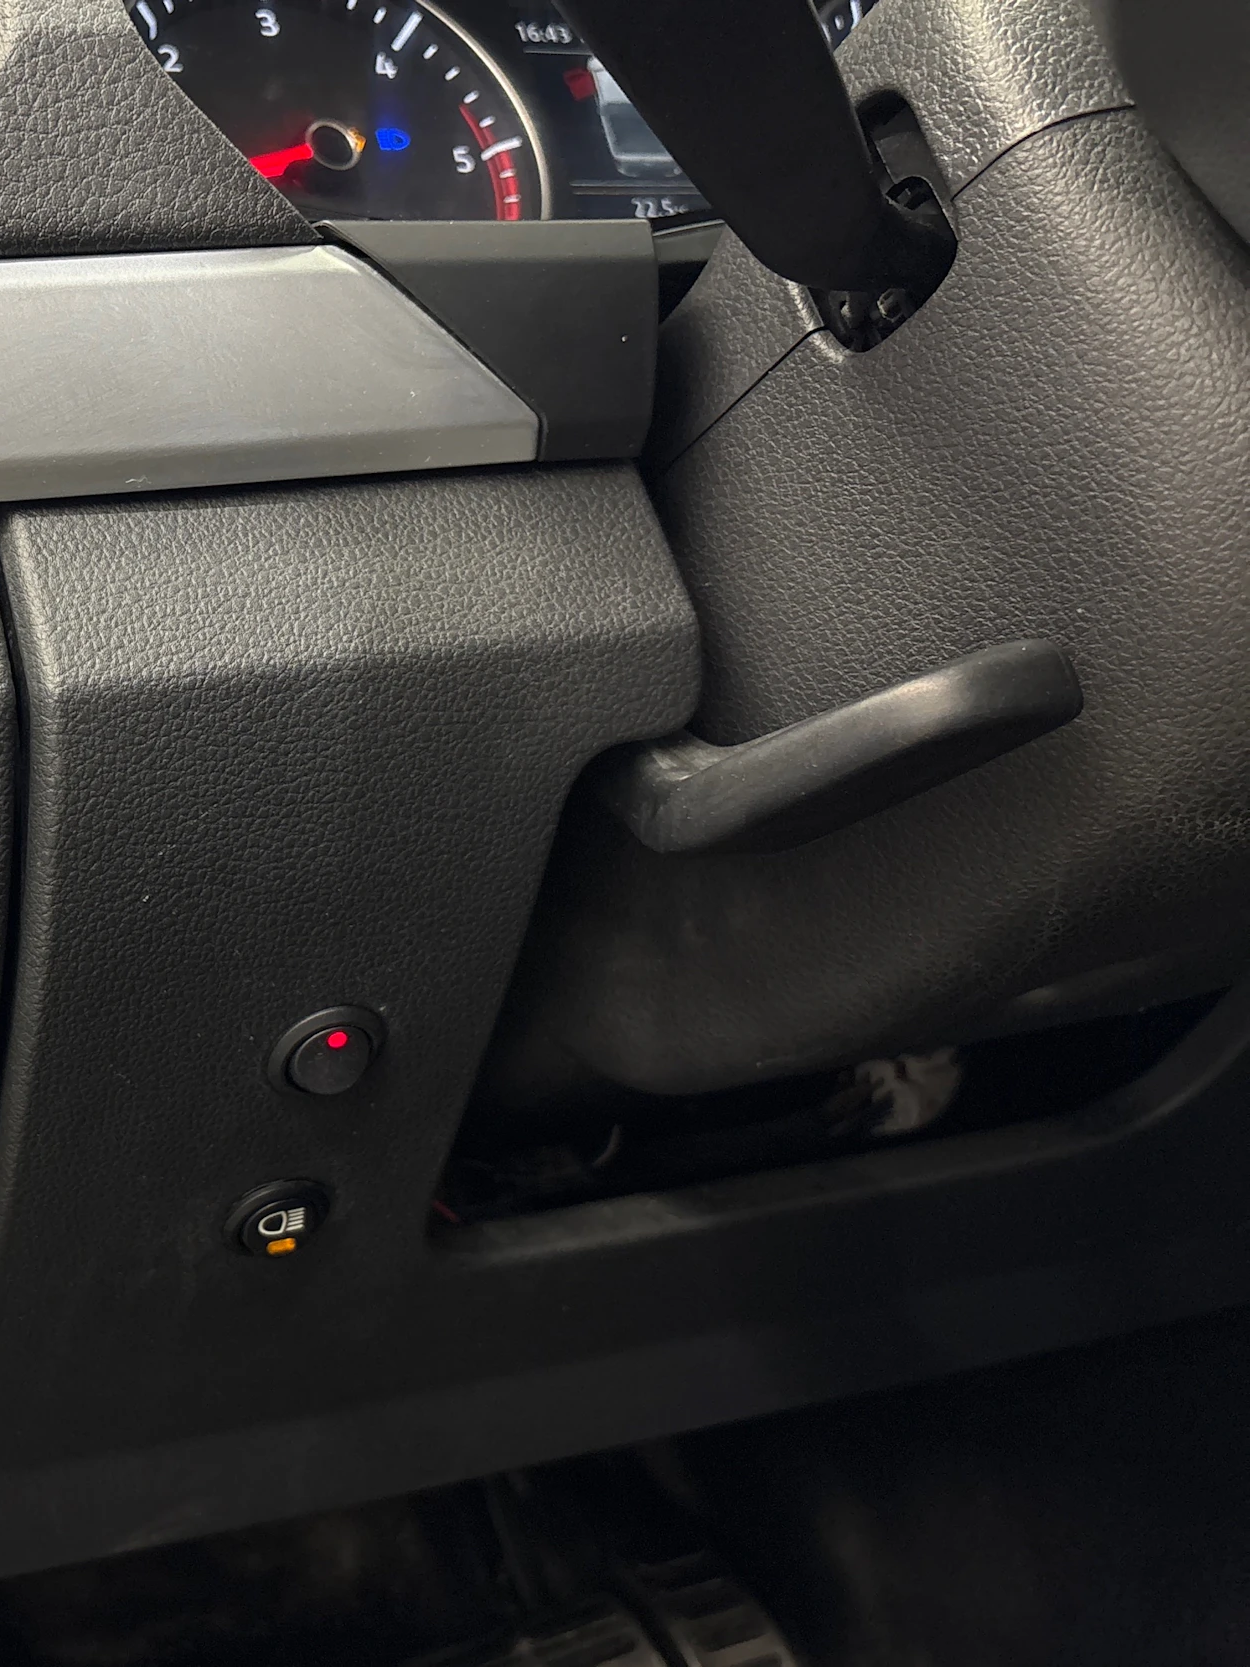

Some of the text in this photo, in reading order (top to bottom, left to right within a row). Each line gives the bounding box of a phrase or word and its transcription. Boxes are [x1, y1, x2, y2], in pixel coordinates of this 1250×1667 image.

[254, 9, 281, 37] 3
[514, 21, 573, 44] 16:43
[157, 44, 184, 73] 2
[374, 51, 398, 79] 4
[452, 145, 476, 174] 5
